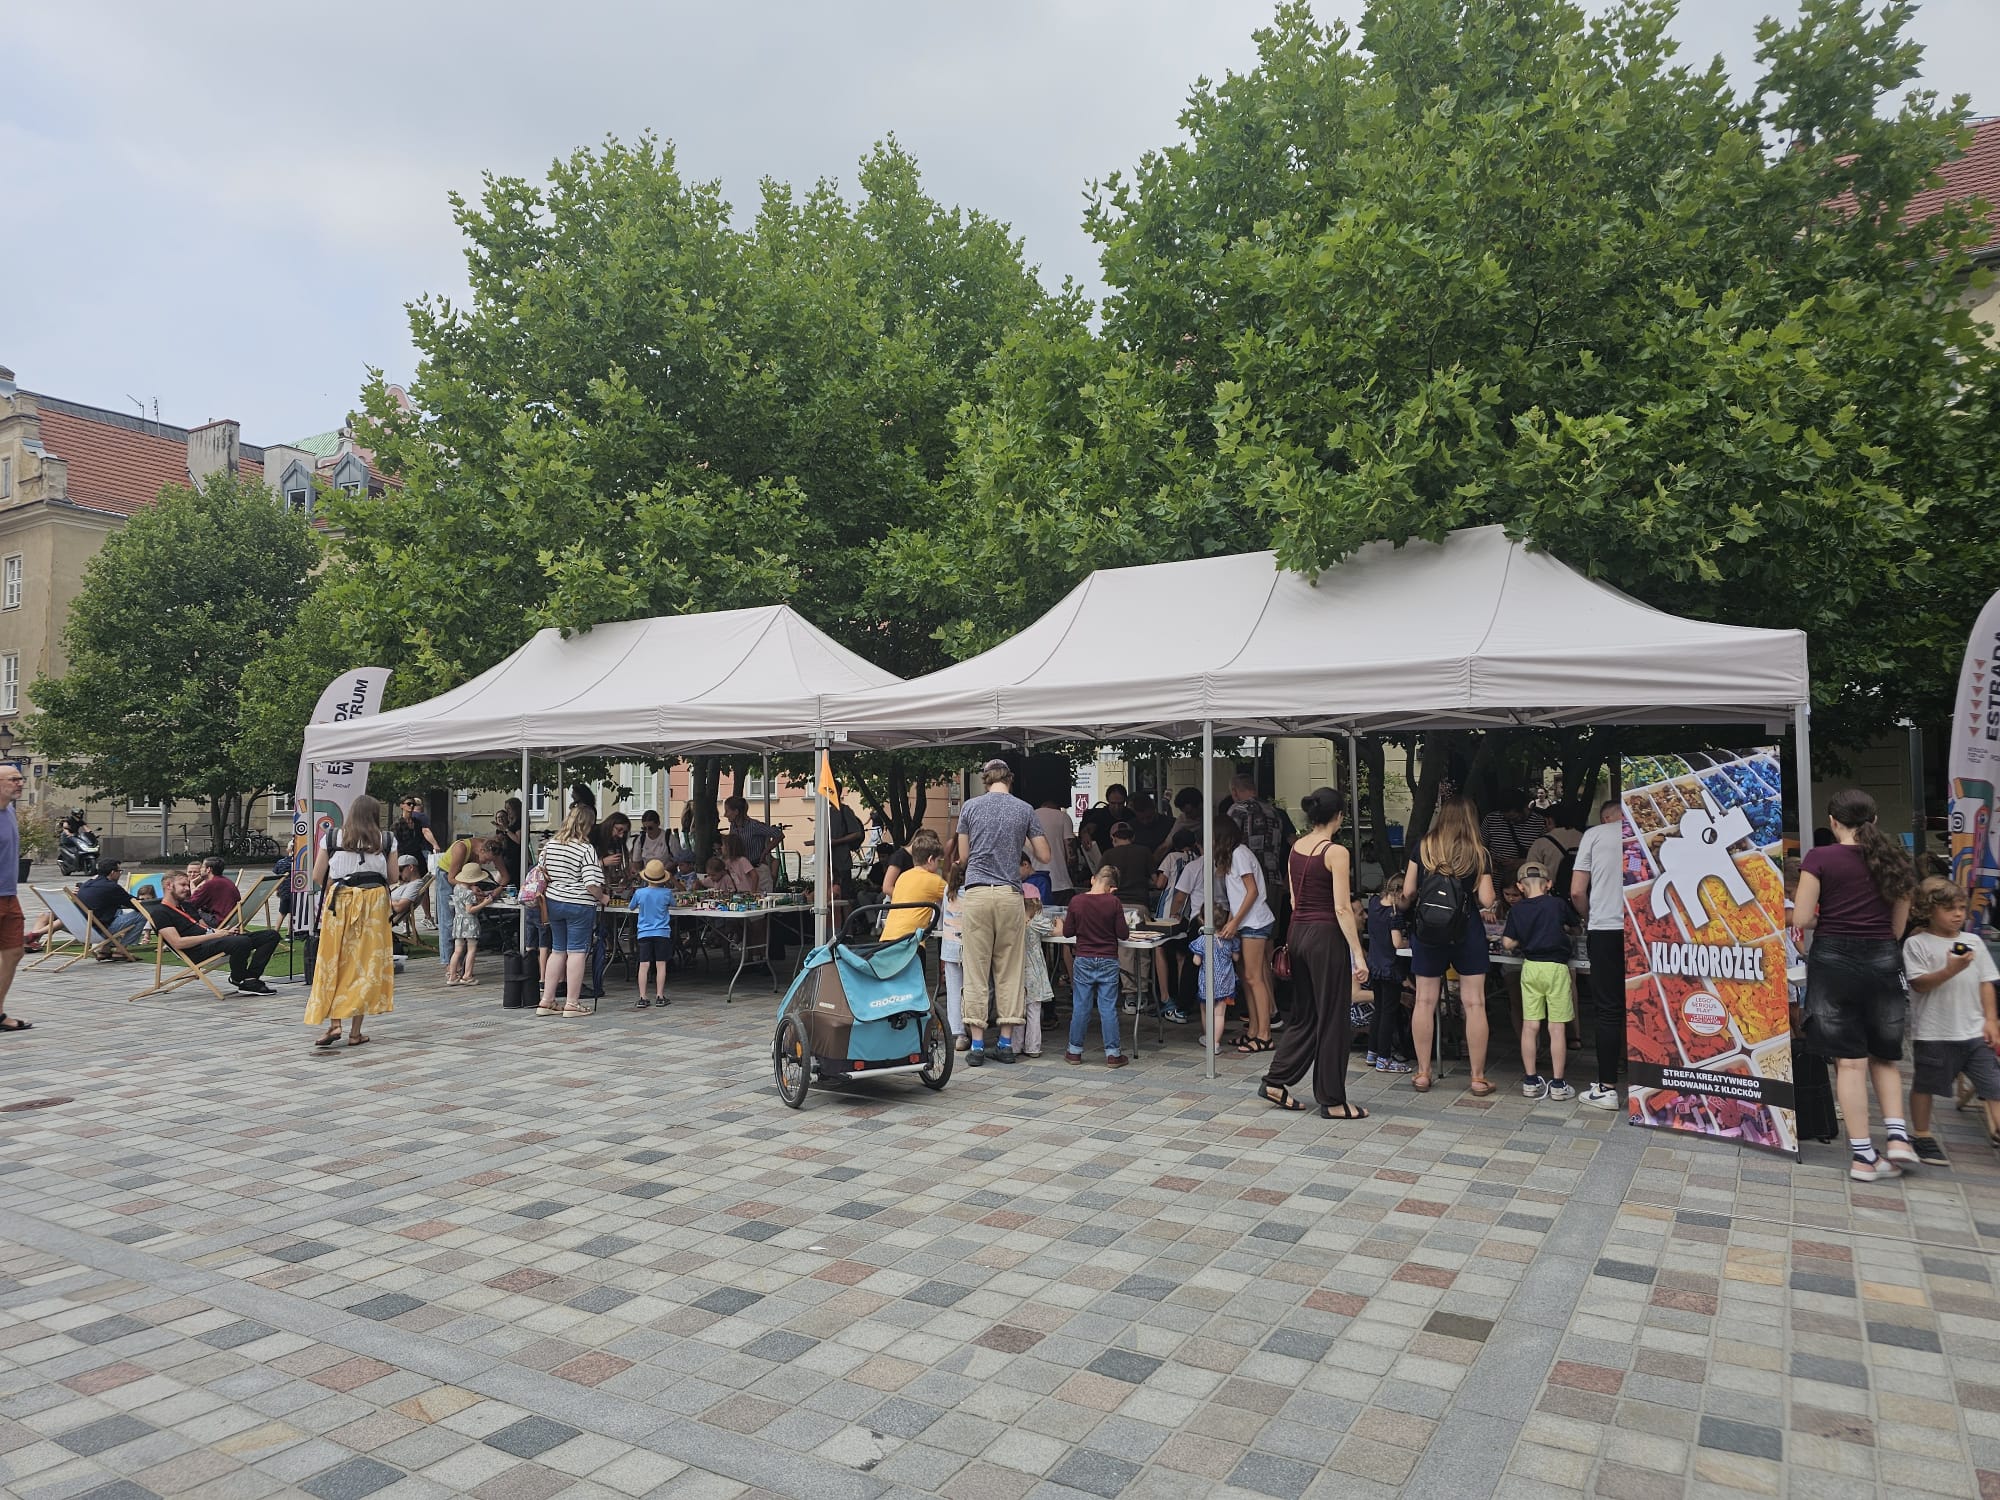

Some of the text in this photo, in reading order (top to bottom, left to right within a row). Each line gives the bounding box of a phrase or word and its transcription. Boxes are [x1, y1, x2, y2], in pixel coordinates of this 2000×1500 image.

[1651, 941, 1764, 980] KLOCKOROŻEC
[1662, 1078, 1762, 1099] BUDOWANIA Z KLOCKÓW
[1663, 1068, 1760, 1088] STREFA KREATYWNEGO
